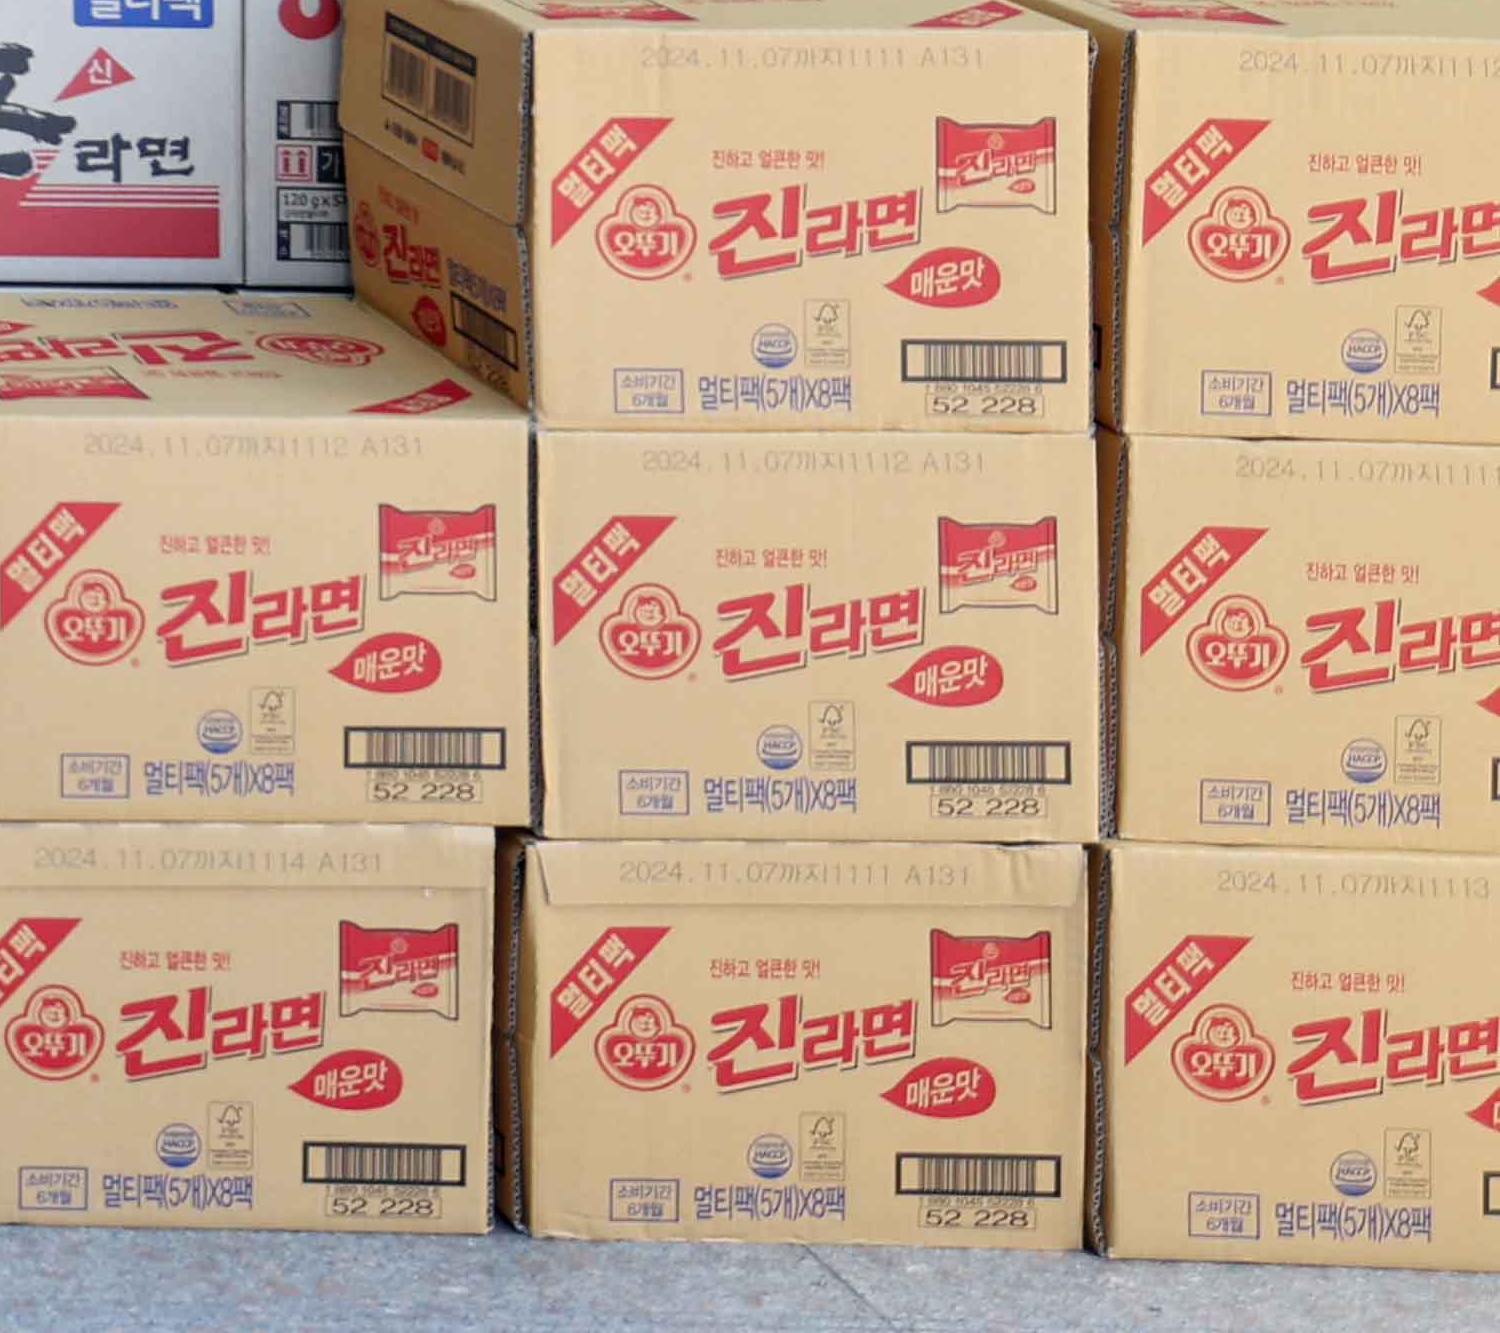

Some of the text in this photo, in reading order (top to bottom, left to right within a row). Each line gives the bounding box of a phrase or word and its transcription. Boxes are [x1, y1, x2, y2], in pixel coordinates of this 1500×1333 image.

[710, 186, 924, 281] 진라면
[909, 256, 987, 299] 매운맛
[24, 1031, 92, 1056] 오뚜기
[119, 987, 326, 1080] 진라면
[332, 1197, 436, 1217] 52 228
